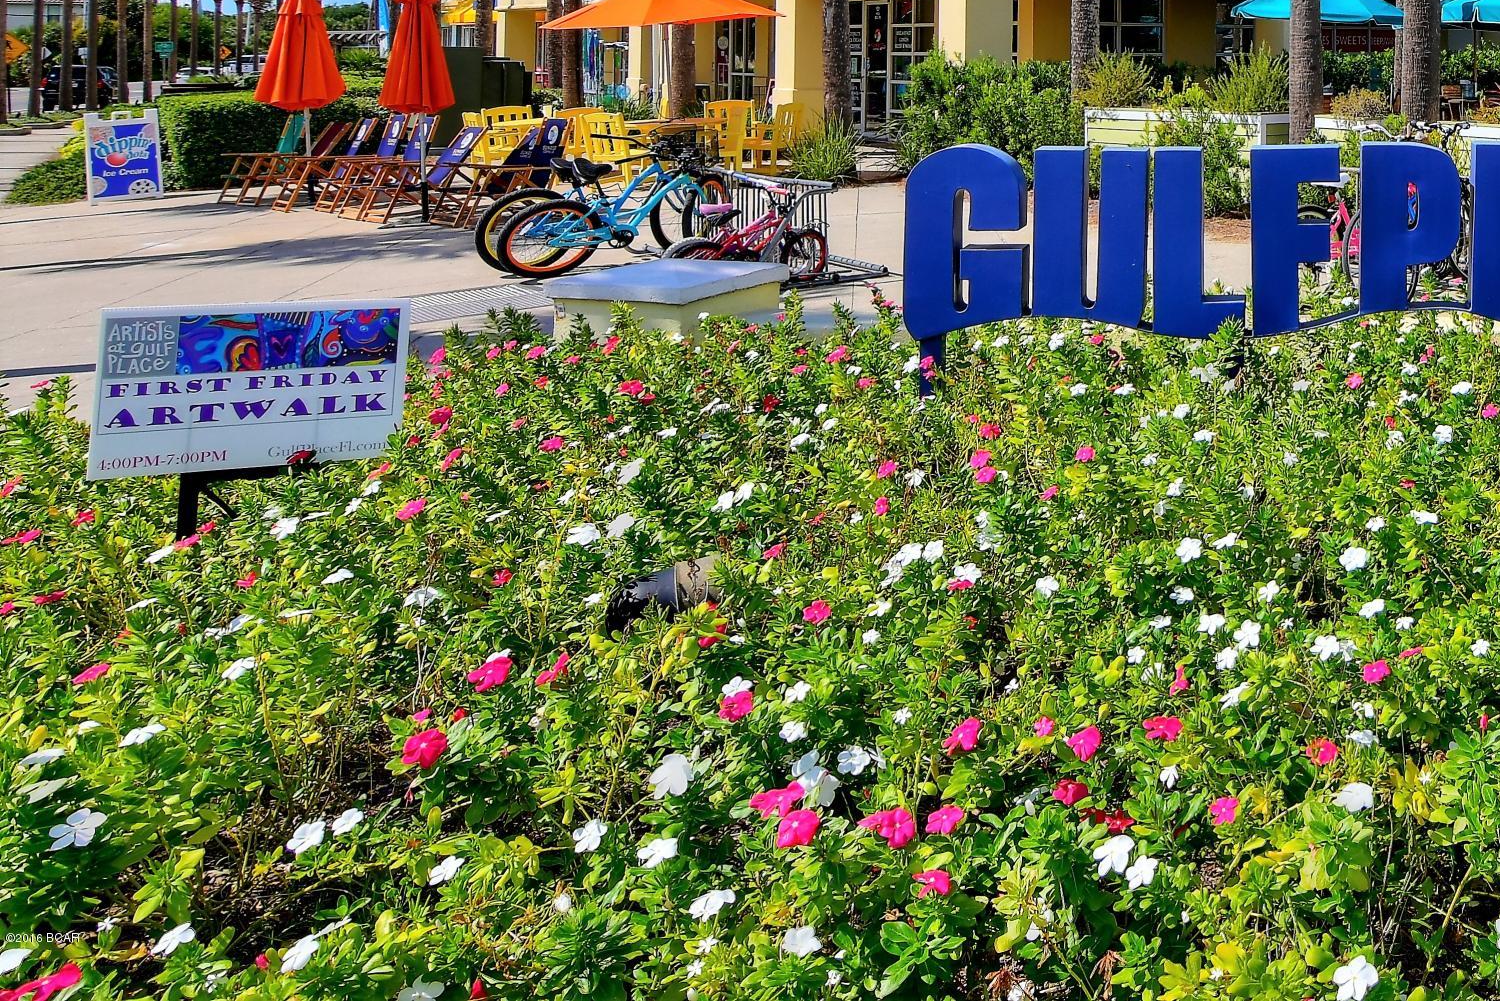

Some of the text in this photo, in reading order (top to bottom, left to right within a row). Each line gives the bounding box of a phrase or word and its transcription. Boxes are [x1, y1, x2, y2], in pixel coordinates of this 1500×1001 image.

[1335, 35, 1367, 45] SWEETS
[119, 168, 149, 176] Cream
[107, 342, 126, 354] at
[105, 369, 388, 399] FIRST FRIDAY
[103, 392, 387, 429] ARTWALK
[96, 449, 229, 471] 4:00PM-7:00PM
